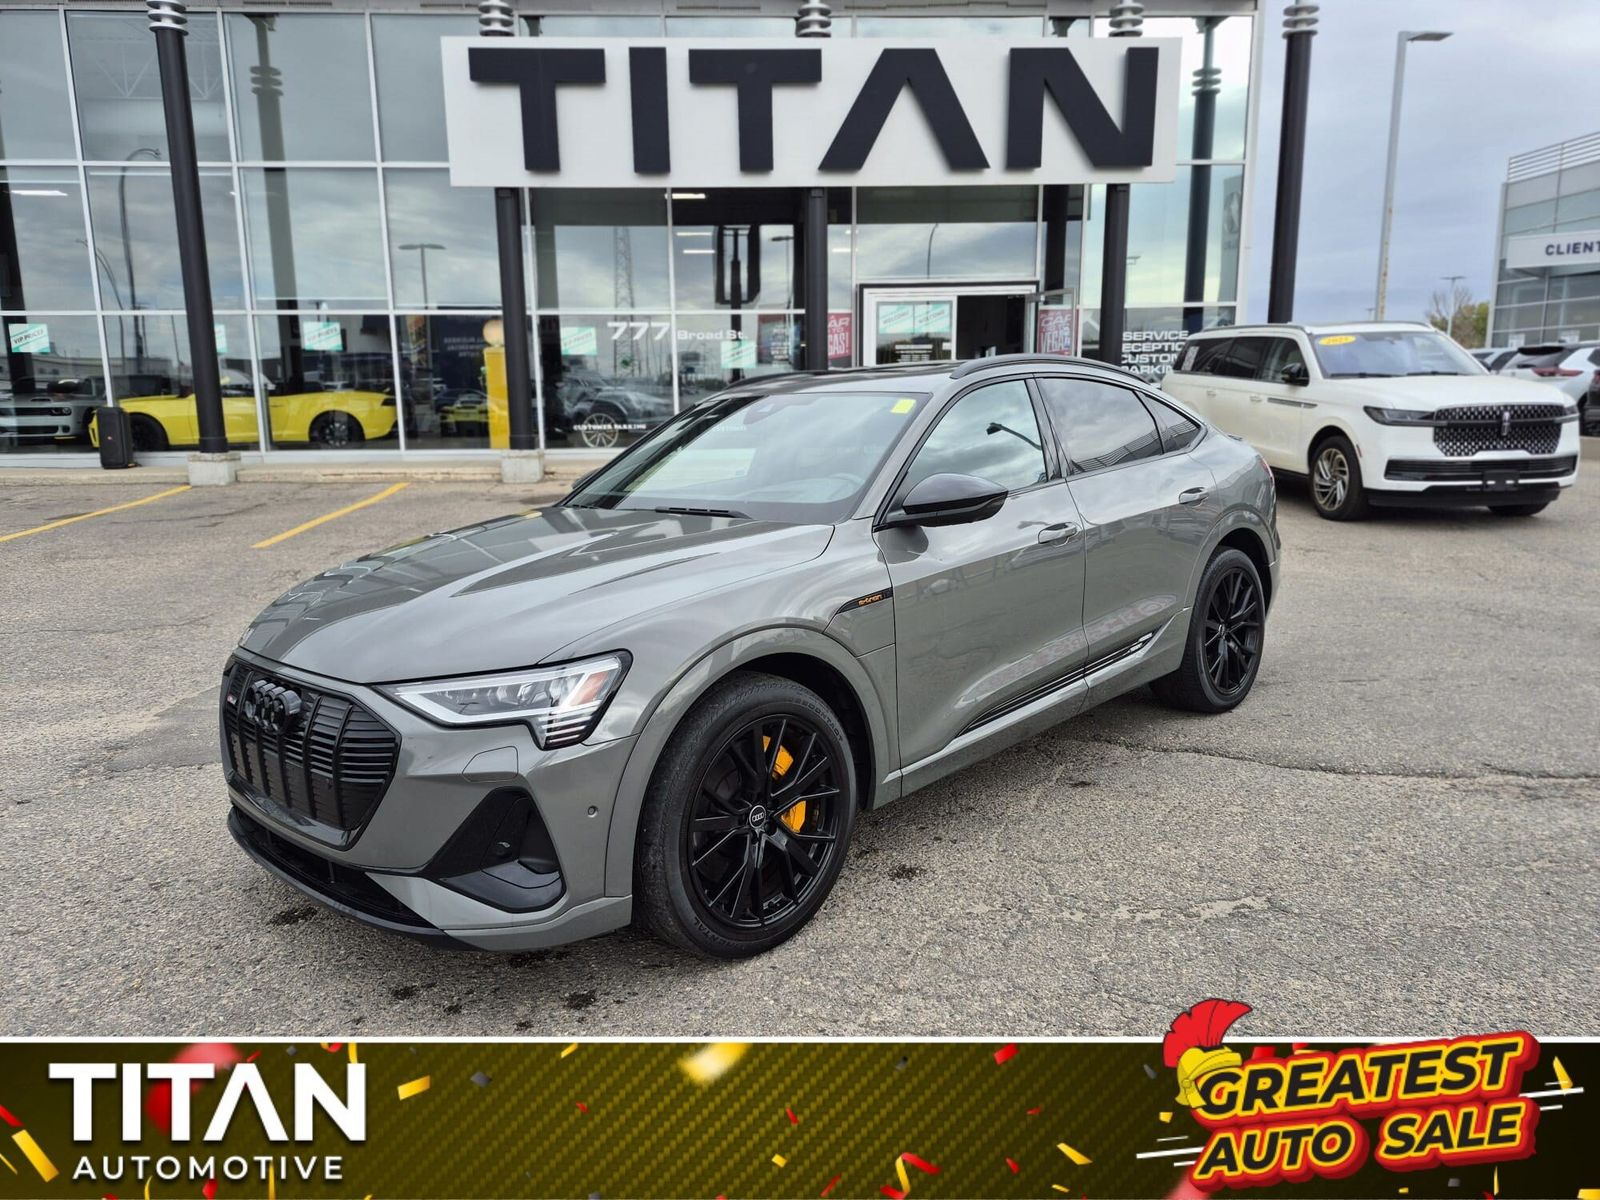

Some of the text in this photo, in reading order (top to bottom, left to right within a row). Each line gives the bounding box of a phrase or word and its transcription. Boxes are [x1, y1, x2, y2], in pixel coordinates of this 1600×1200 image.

[467, 46, 1160, 174] TITAN
[827, 317, 849, 328] AR
[606, 321, 749, 341] 777 Broad St.
[1122, 330, 1189, 341] SERVICE
